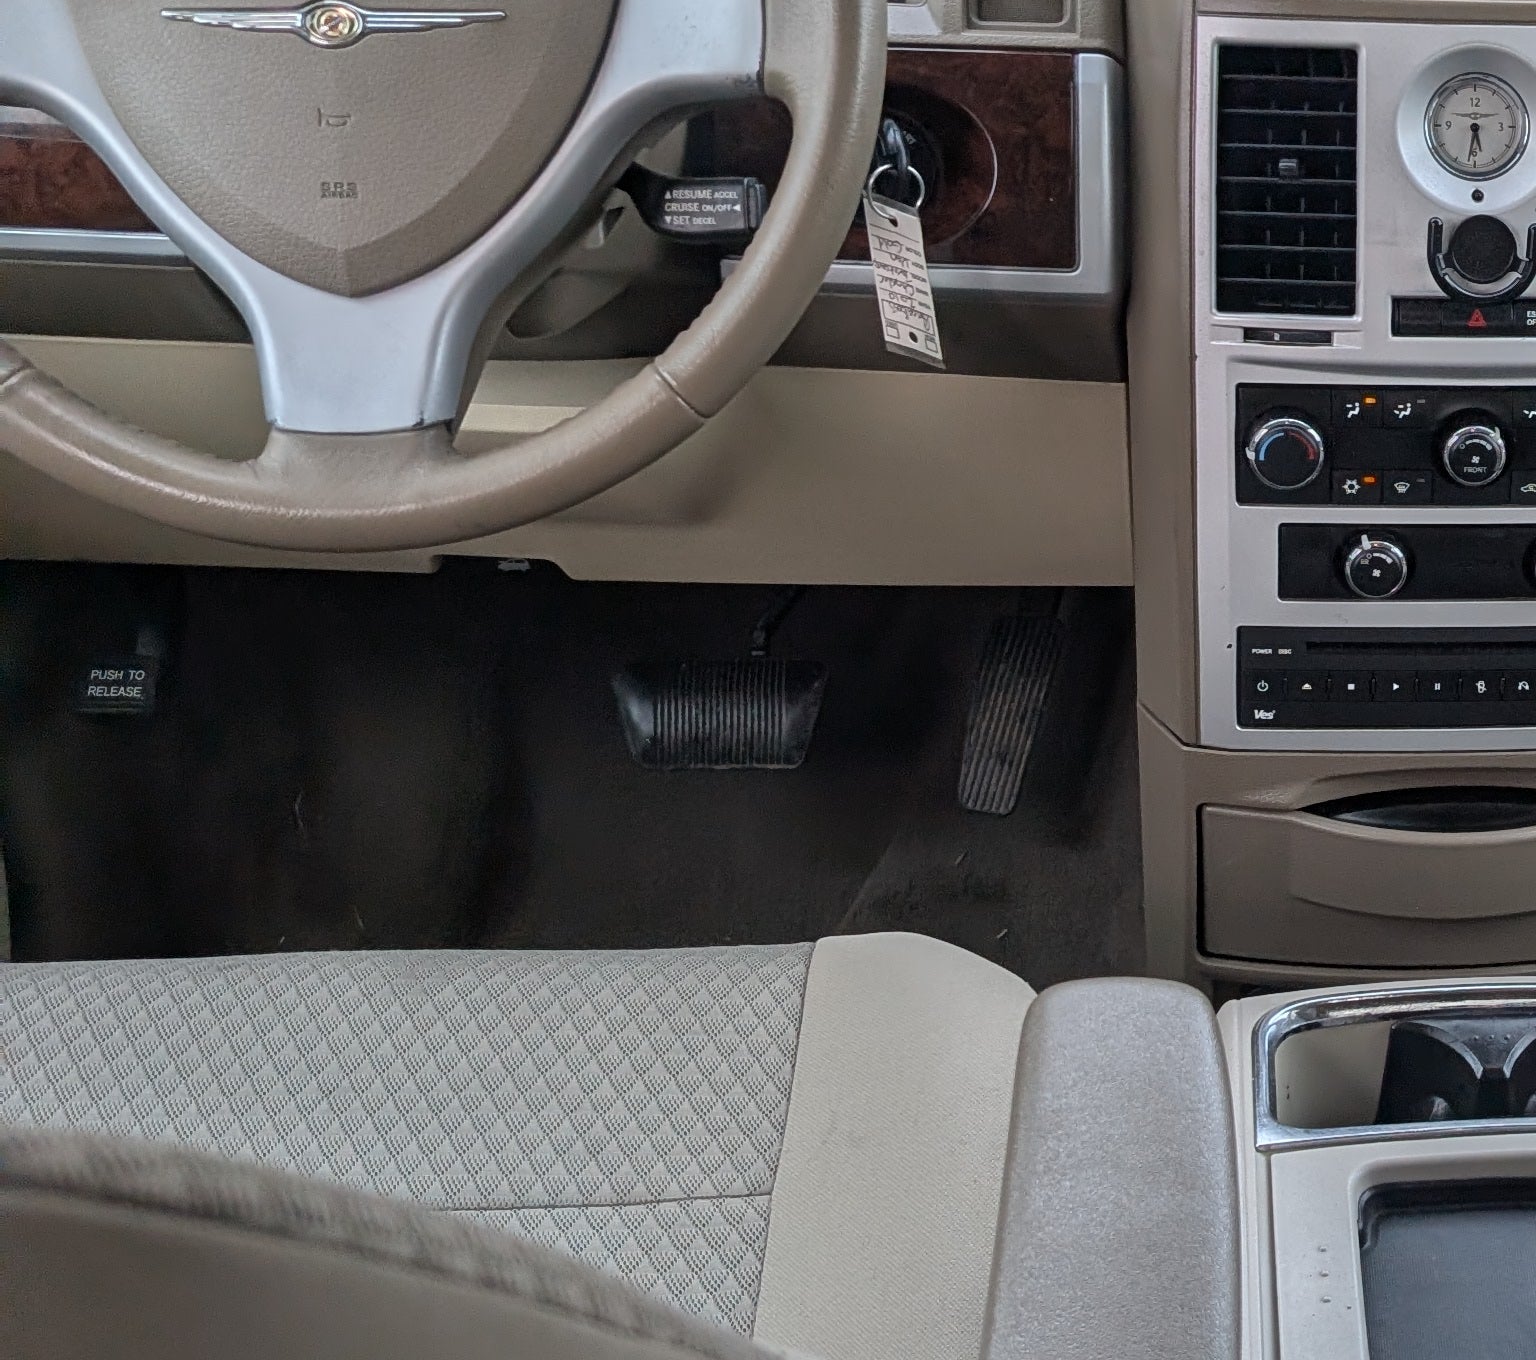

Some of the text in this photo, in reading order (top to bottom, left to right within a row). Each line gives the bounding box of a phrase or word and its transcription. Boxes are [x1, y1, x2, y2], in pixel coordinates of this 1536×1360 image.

[1470, 97, 1481, 108] 12
[1445, 120, 1452, 130] 9
[1498, 122, 1504, 132] 3
[1471, 148, 1478, 157] 6
[672, 189, 713, 200] RESUME
[665, 202, 733, 213] CRUISE ON/OFF
[673, 215, 690, 225] SET
[1463, 466, 1487, 474] FRONT
[91, 669, 146, 681] PUSH TO
[87, 686, 143, 697] RELEASE
